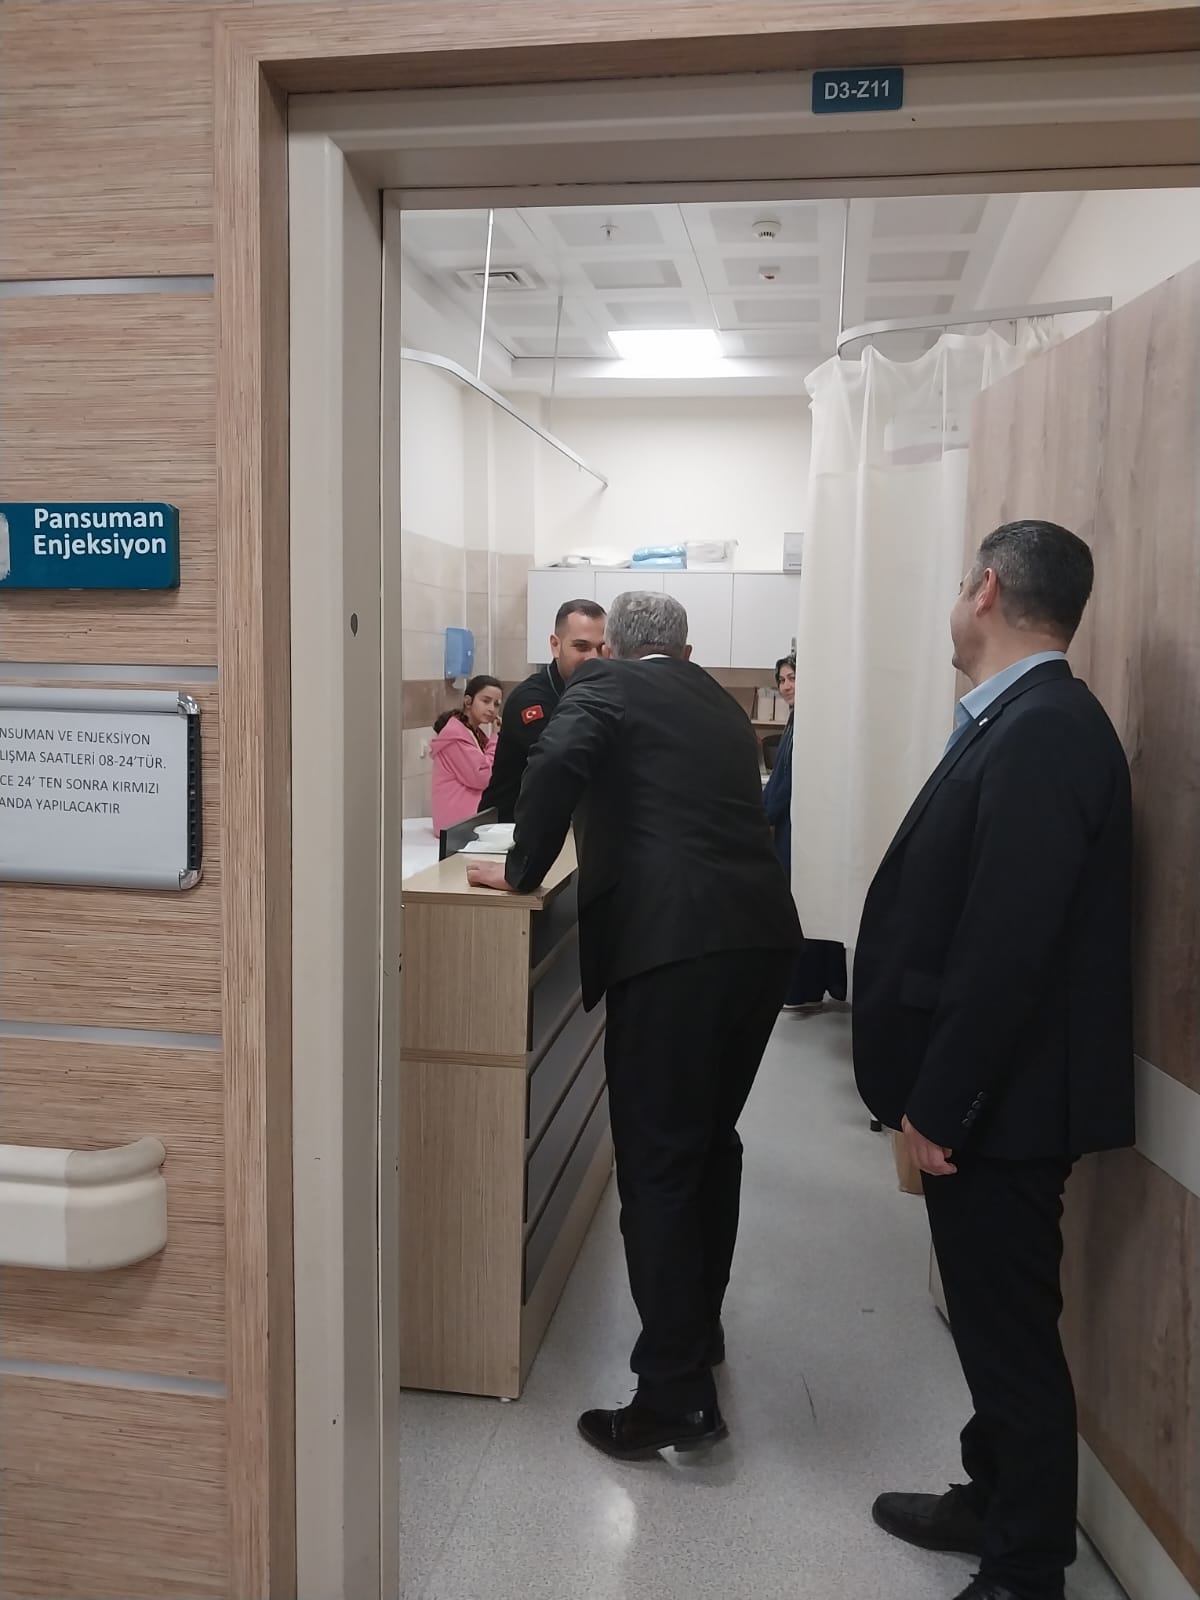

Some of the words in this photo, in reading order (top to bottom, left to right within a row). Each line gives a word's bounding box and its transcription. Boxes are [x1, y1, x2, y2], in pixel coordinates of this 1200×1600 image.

[824, 79, 890, 100] D3-Z11
[34, 508, 164, 529] Pansuman
[33, 533, 167, 560] Enjeksiyon
[58, 730, 73, 742] VE
[77, 730, 151, 746] ENJEKSİYON
[39, 752, 95, 766] SAATLERİ
[39, 776, 62, 789] TEN
[66, 779, 109, 792] SONRA
[112, 781, 159, 794] KIRMIZI
[35, 799, 120, 814] YAPILACAKTIR
